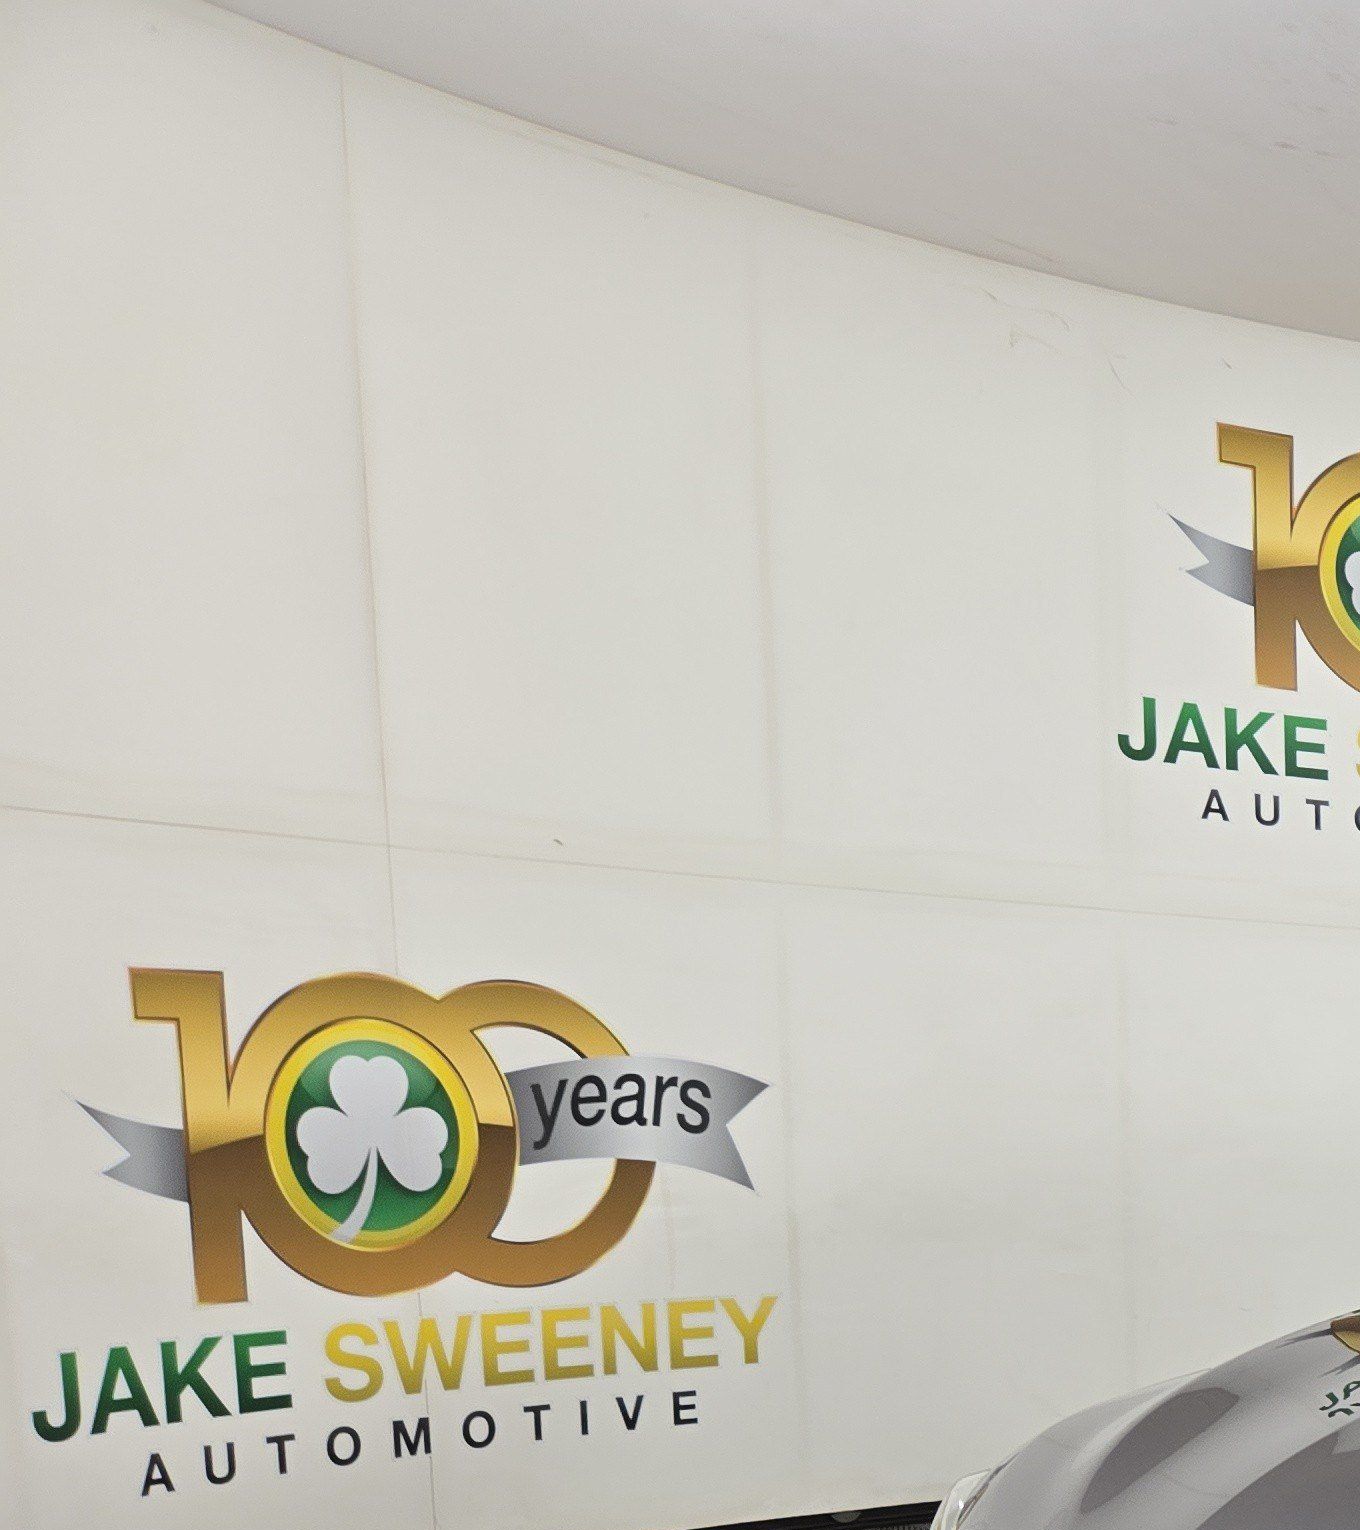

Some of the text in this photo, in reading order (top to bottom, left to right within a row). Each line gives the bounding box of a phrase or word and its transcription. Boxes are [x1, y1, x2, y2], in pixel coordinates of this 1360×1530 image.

[1117, 696, 1330, 781] JAKE
[128, 966, 713, 1306] 100 years
[31, 1296, 778, 1444] JAKE SWEENEY
[141, 1390, 700, 1498] AUTOMOTIVE
